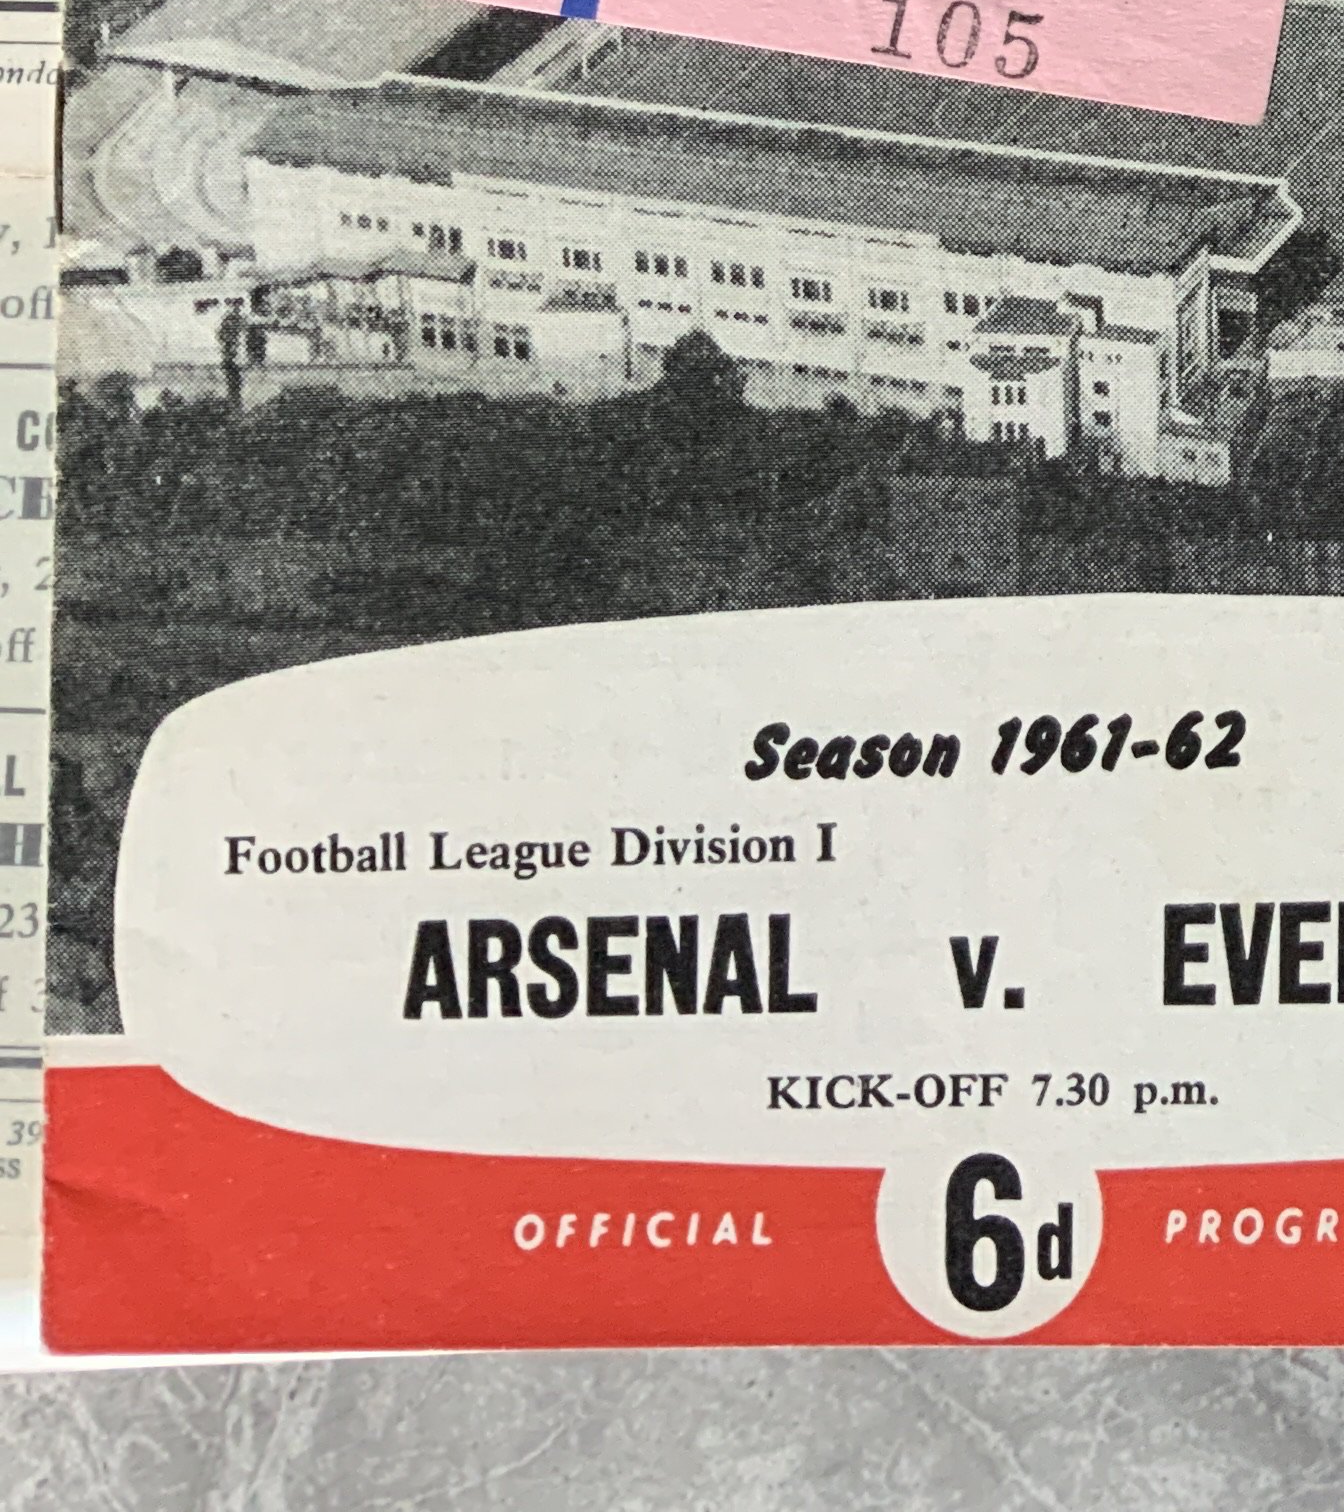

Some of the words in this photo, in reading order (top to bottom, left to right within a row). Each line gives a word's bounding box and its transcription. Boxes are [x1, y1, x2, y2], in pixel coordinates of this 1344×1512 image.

[744, 721, 961, 781] Season
[991, 709, 1247, 776] 1961-62
[224, 832, 406, 876] Football
[429, 831, 591, 880] League
[611, 824, 795, 867] Division
[815, 822, 838, 863] I
[403, 913, 819, 1020] ARSENAL
[949, 936, 1025, 1009] v.
[767, 1073, 1009, 1109] KICK-OFF
[1032, 1072, 1110, 1108] 7.30
[1133, 1080, 1219, 1113] p.m.
[513, 1211, 774, 1251] OFFICIAL
[945, 1152, 1073, 1312] 6d
